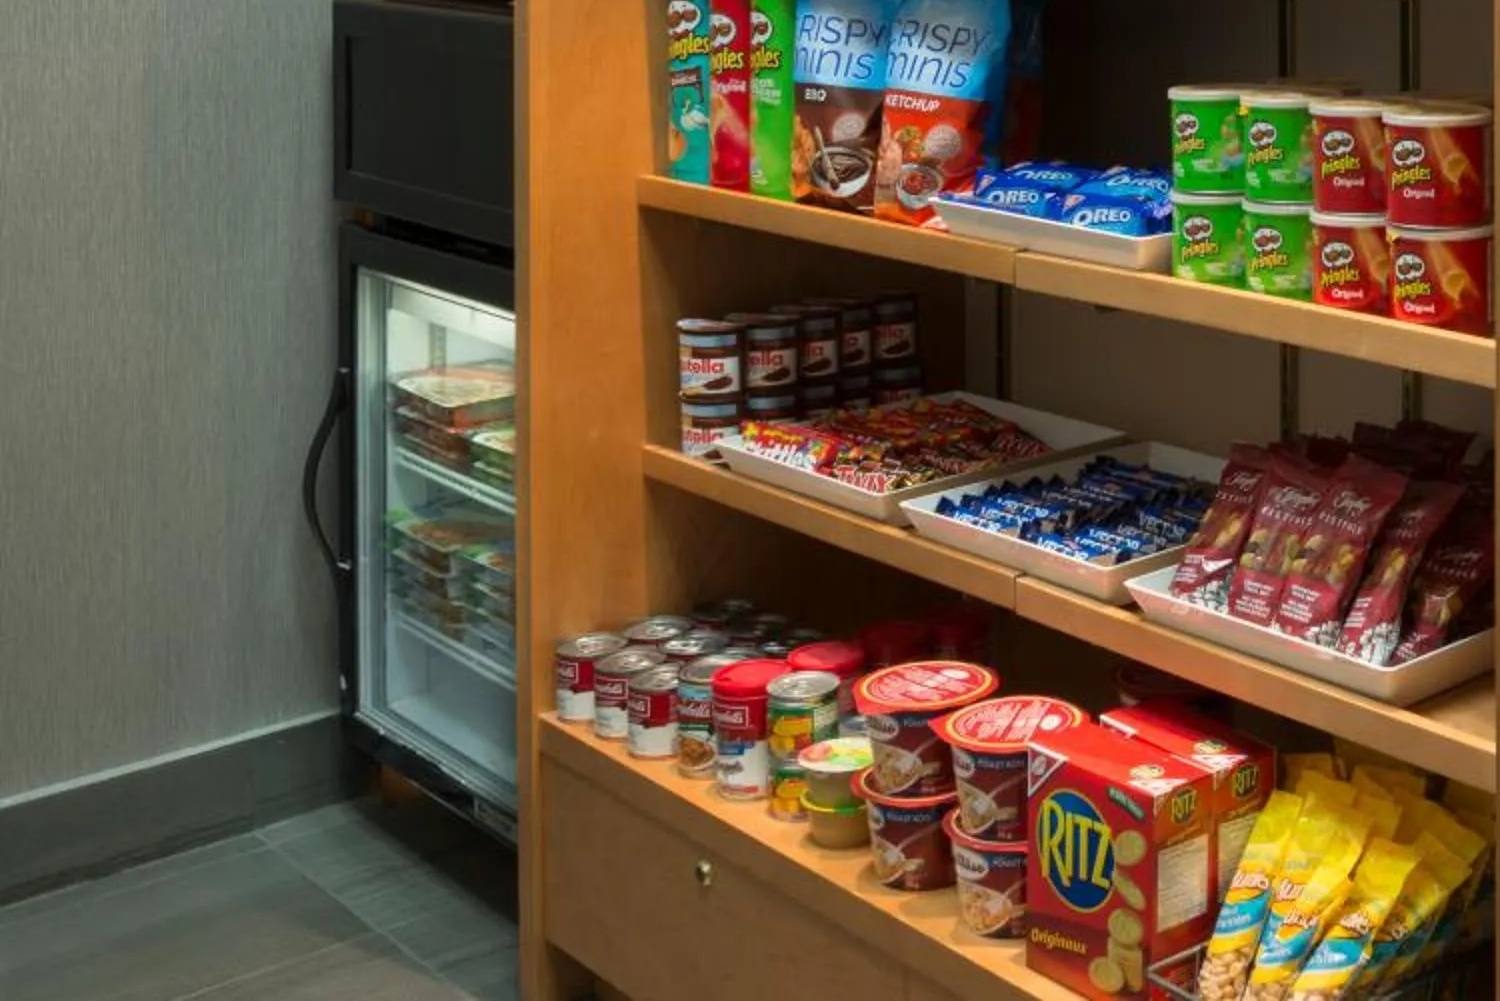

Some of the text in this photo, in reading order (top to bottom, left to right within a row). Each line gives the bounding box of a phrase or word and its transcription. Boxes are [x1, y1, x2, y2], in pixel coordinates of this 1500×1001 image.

[799, 13, 890, 47] RISPY
[885, 93, 941, 113] KETCHUP
[1391, 167, 1433, 190] Pringles
[986, 189, 1039, 205] OREO
[1072, 208, 1133, 226] OREO
[1038, 797, 1114, 889] RITZ
